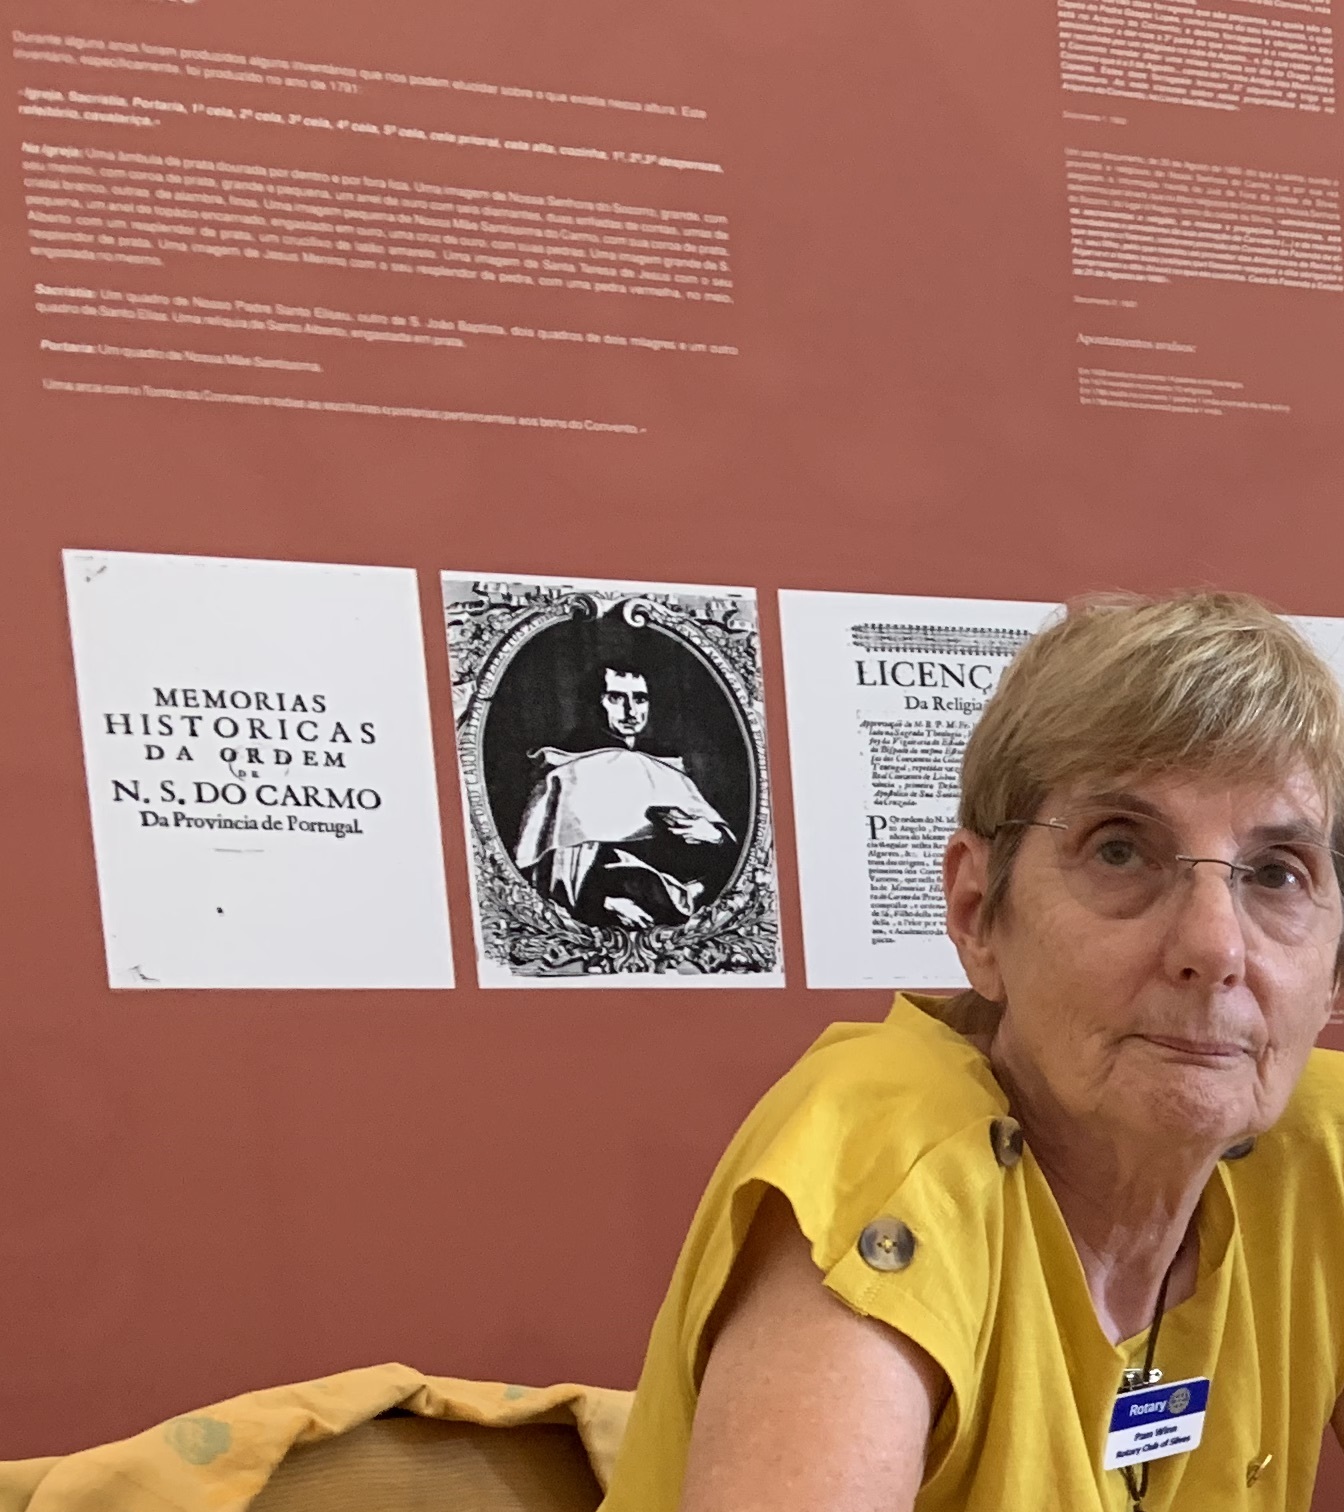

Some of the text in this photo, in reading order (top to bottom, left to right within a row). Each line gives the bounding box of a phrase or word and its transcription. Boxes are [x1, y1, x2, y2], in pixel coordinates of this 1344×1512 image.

[855, 660, 994, 695] LICENÇ
[153, 687, 326, 713] MEMORIAS
[904, 696, 928, 710] Da
[104, 713, 376, 744] HISTORICAS
[144, 744, 347, 768] DA ORDEM
[111, 780, 381, 811] N. S. DO CARMO
[139, 811, 169, 828] Da
[173, 811, 258, 830] Provincia
[261, 815, 283, 831] de
[1129, 1400, 1167, 1417] Rotary
[1116, 1447, 1141, 1458] Rotary
